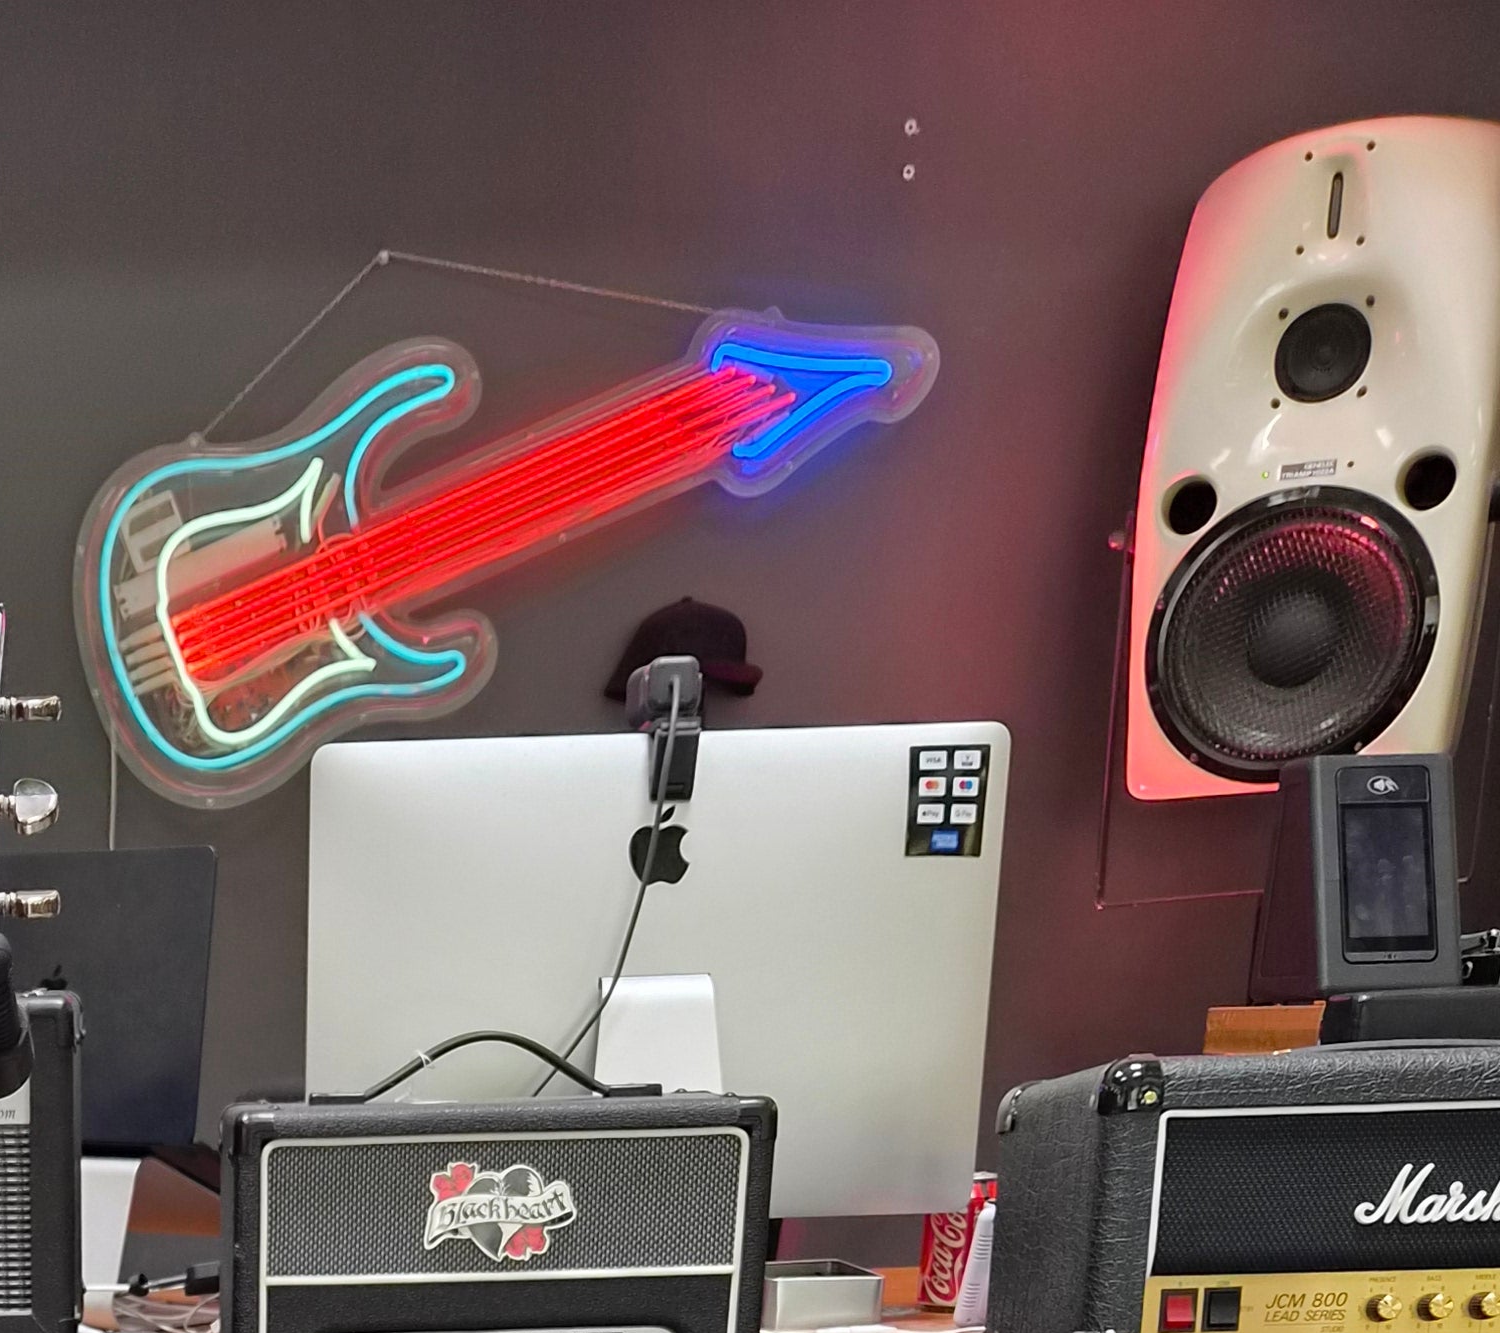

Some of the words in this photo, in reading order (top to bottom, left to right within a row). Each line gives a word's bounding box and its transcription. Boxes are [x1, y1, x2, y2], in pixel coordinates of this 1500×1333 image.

[438, 1190, 567, 1230] Blackheart
[1266, 1293, 1306, 1310] JCM
[1311, 1292, 1348, 1307] 800
[1264, 1310, 1300, 1323] LEAD
[1304, 1309, 1346, 1322] SERIES
